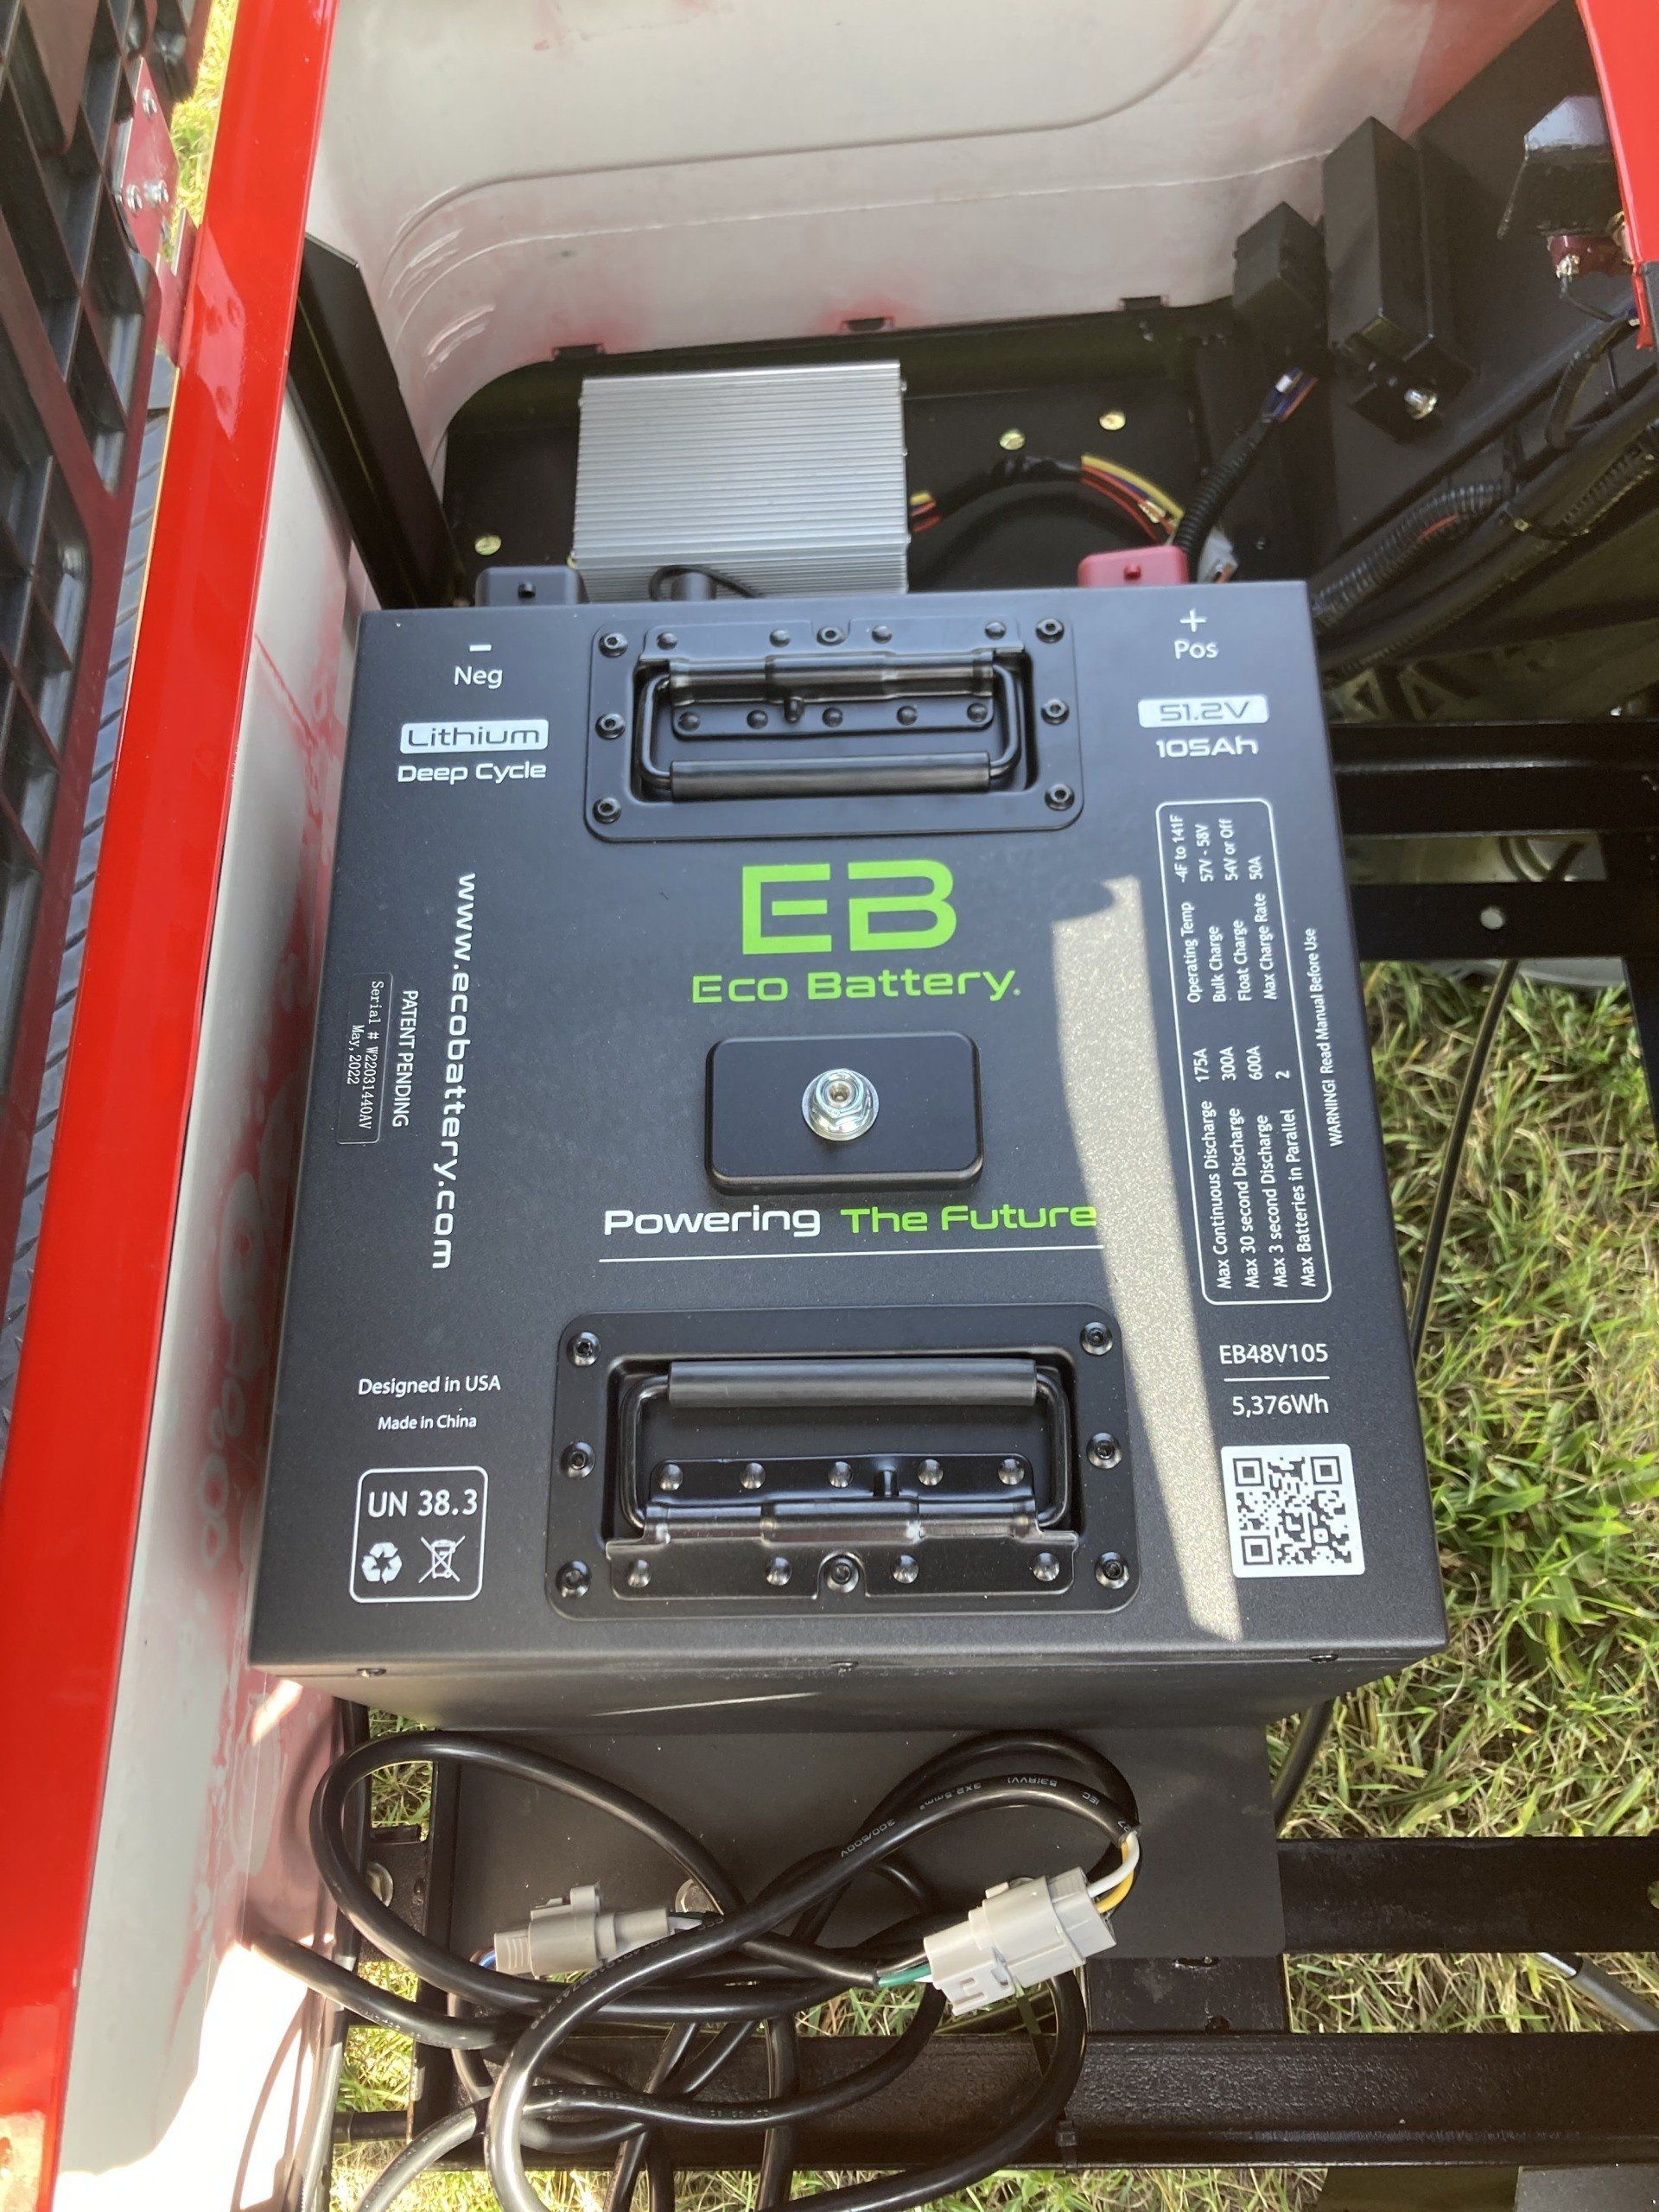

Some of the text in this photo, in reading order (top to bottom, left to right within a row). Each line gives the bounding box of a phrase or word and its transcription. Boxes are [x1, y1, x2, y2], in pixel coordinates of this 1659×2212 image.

[1174, 639, 1218, 659] Pos
[454, 665, 503, 690] Neg
[1160, 701, 1250, 722] 51.2V
[408, 726, 540, 747] Lithium
[1156, 735, 1259, 758] 105Ah
[397, 760, 547, 785] Deep Cycle
[1169, 814, 1188, 883] -4F to 141F
[1195, 823, 1211, 848] 58V
[1218, 818, 1238, 881] 54V or Off
[1199, 858, 1214, 882] 57V
[1248, 855, 1263, 880] 50A
[742, 859, 957, 955] EB
[1180, 902, 1201, 1003] Operating Temp
[1209, 925, 1227, 1002] Bulk Charge
[1233, 919, 1252, 1002] Float Charge
[1255, 893, 1278, 1000] Max Charge Rate
[368, 981, 385, 1025] Serial
[692, 974, 788, 1003] Eco
[1304, 927, 1343, 1147] WARNING! Read Manual Before Use
[391, 989, 419, 1128] PATENT PENDING
[432, 873, 476, 1268] www.ecobattery.com
[1192, 1048, 1210, 1083] 175A
[1219, 1046, 1237, 1081] 300A
[1246, 1046, 1264, 1080] 600A
[1275, 1070, 1290, 1079] 2
[1201, 1100, 1232, 1289] Max Continuous Discharge
[1228, 1108, 1260, 1288] Max 30 second Discharge
[1256, 1114, 1288, 1288] Max 3 second Discharge
[1280, 1109, 1316, 1287] Max Batteries in Parallel
[604, 1203, 1097, 1237] Powering The Future
[1218, 1343, 1329, 1364] EB48V105
[358, 1375, 502, 1398] Designed in USA
[378, 1414, 477, 1430] Made in China
[1231, 1393, 1330, 1419] 5,376Wh
[367, 1489, 478, 1517] UN 38.3
